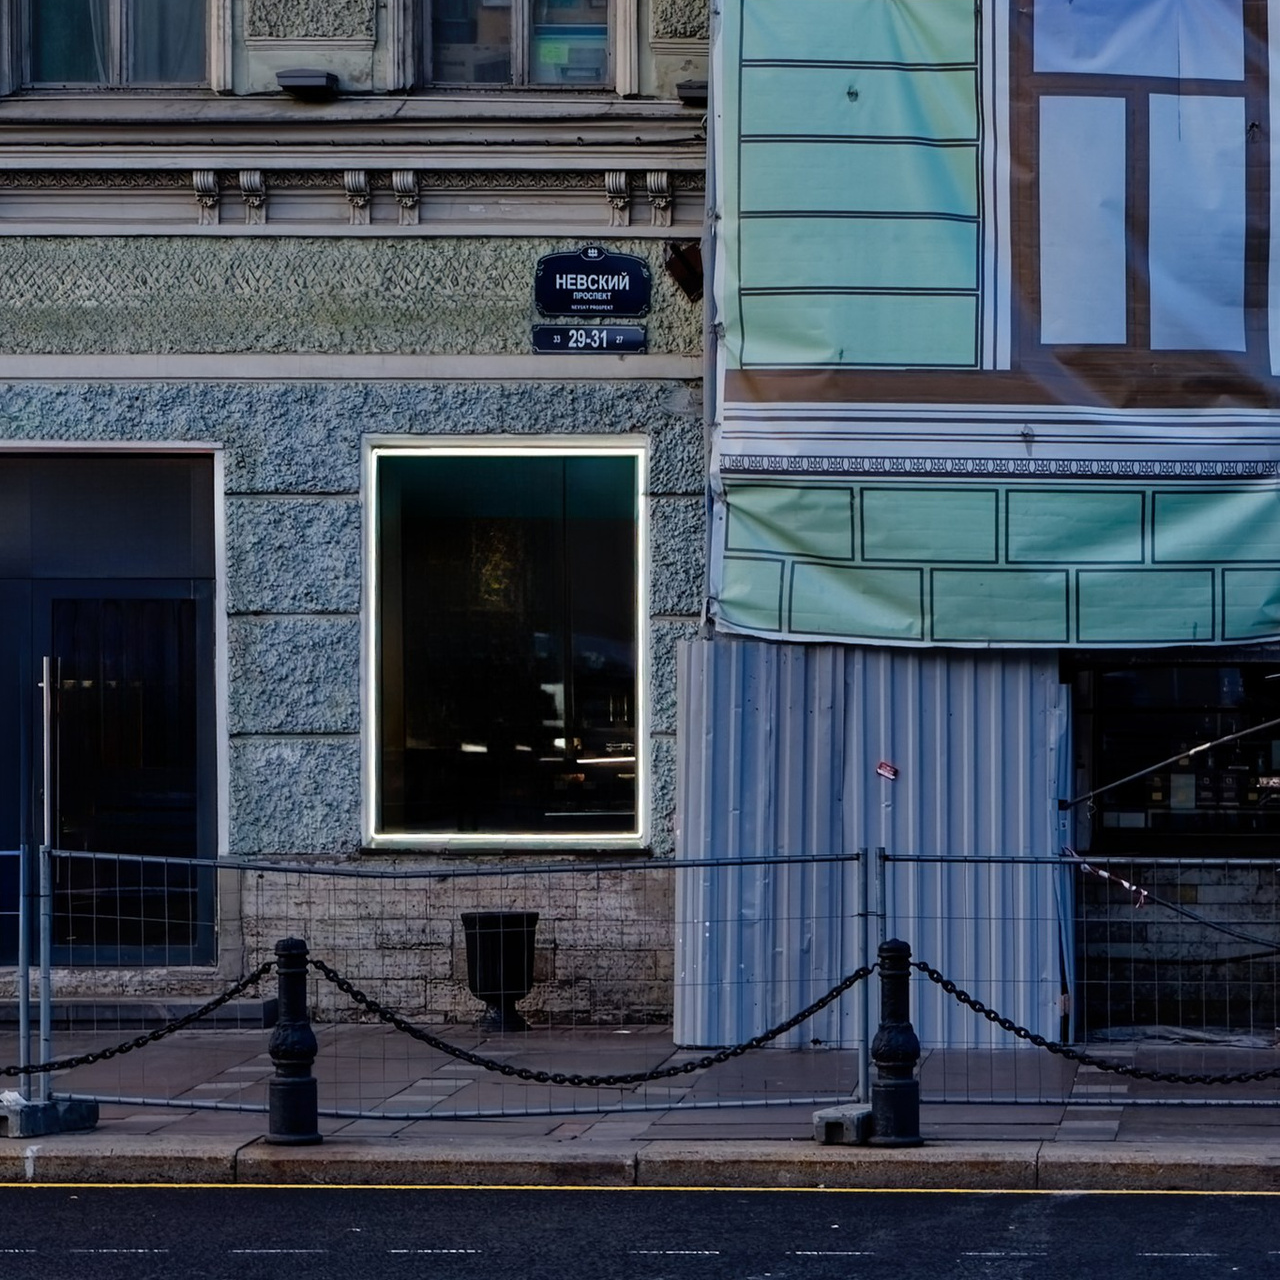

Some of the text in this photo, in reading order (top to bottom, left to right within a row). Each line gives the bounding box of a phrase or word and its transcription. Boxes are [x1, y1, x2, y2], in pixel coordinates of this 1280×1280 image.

[556, 272, 630, 290] НЕВСКИЙ
[573, 292, 612, 300] ПРОСПЕКТ
[553, 329, 624, 348] 33 29-31 27
